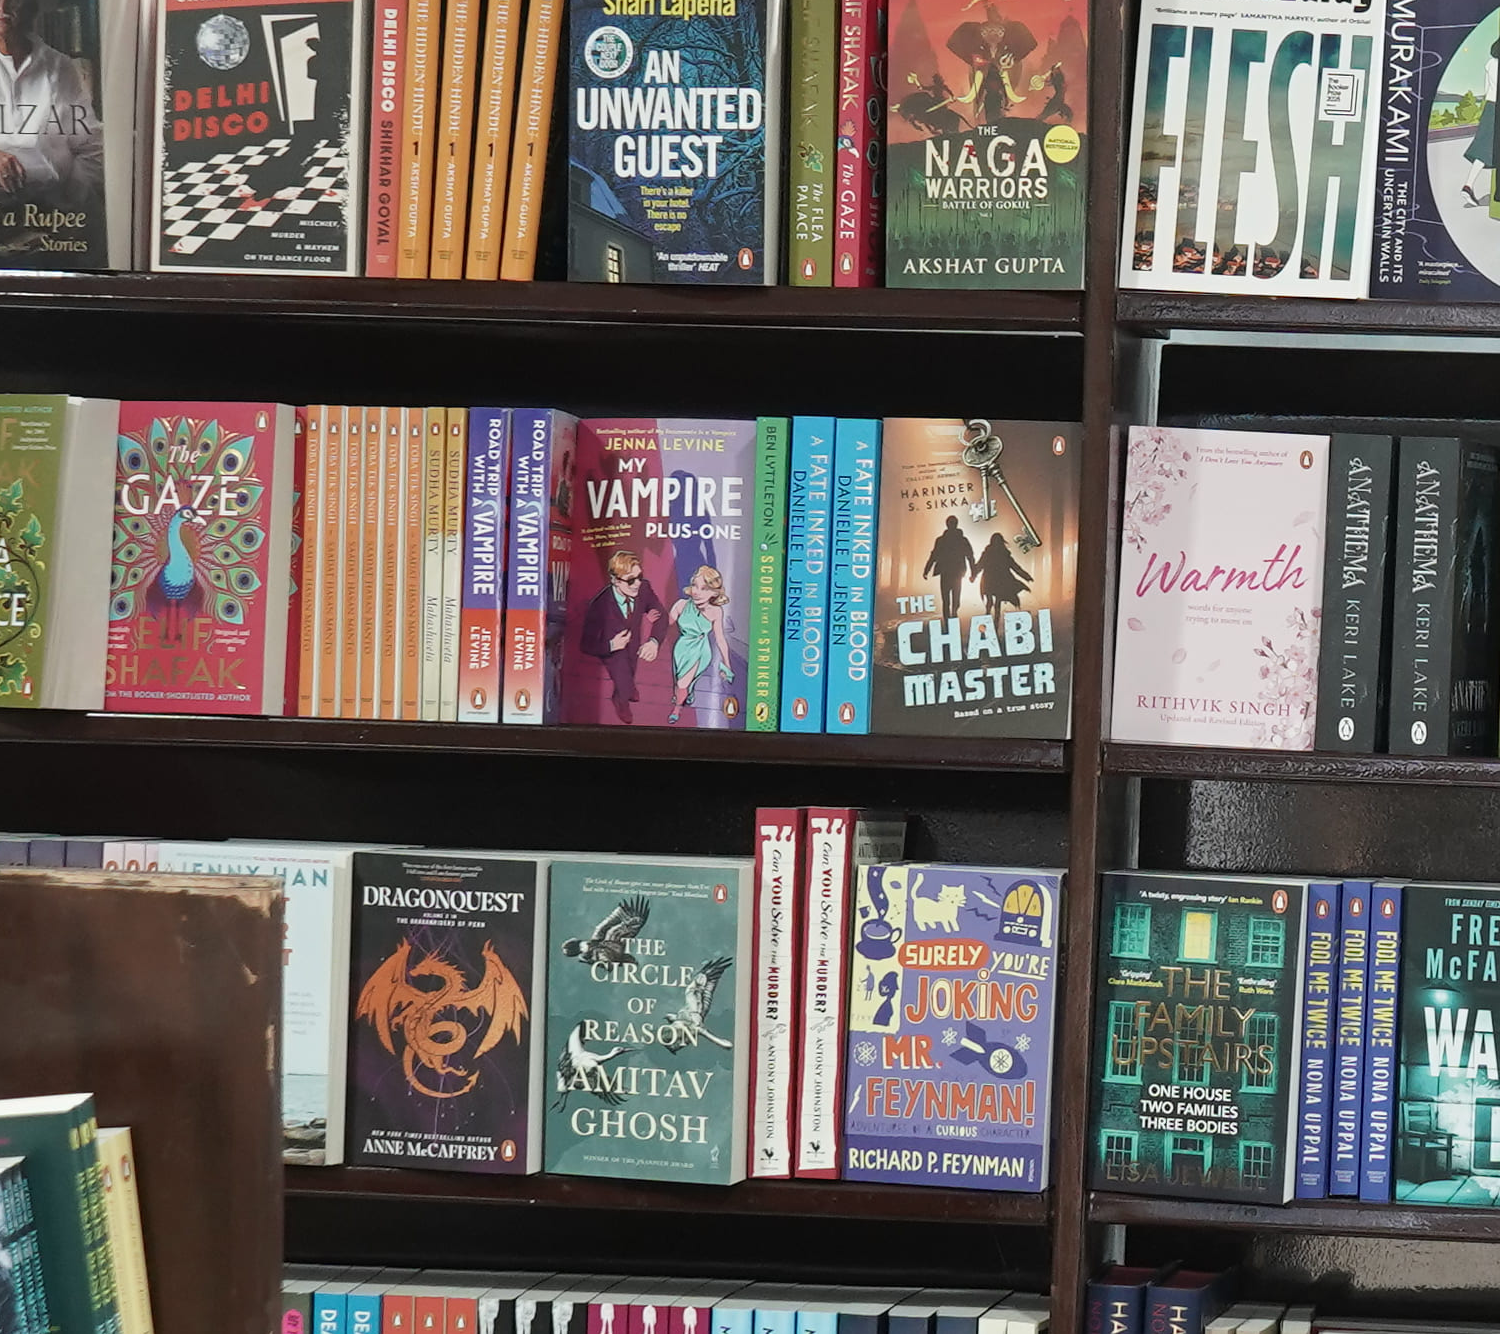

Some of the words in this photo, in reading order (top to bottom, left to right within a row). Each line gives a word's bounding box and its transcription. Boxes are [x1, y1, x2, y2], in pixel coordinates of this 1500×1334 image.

[644, 51, 680, 85] AN
[174, 81, 270, 112] DELHI
[577, 88, 762, 131] UNWANTED
[172, 111, 270, 141] DISCO
[614, 135, 723, 179] GUEST
[925, 136, 1047, 178] NAGA
[926, 178, 1049, 199] WARRIORS
[902, 256, 988, 275] AKSHAT
[996, 257, 1066, 275] GUPTA
[619, 458, 646, 474] MY
[121, 474, 241, 517] GAZE
[587, 476, 743, 521] VAMPIRE
[645, 522, 741, 541] PLUS-ONE
[1136, 542, 1309, 598] Warmth
[895, 596, 936, 613] THE
[900, 610, 1055, 668] CHABI
[904, 662, 1056, 707] MASTER
[362, 884, 525, 916] DRAGONQUEST
[623, 938, 667, 957] THE
[904, 943, 983, 967] SURELY
[990, 951, 1050, 978] YOU'RE
[590, 960, 695, 987] CIRCLE
[627, 998, 657, 1015] OF
[905, 969, 1038, 1024] JOKING
[583, 1019, 699, 1047] REASON
[882, 1034, 943, 1071] MR.
[565, 1065, 714, 1101] AMITAV
[865, 1077, 1036, 1126] FEYNMAN!
[570, 1107, 709, 1145] GHOSH
[849, 1148, 921, 1173] RICHARD
[926, 1151, 940, 1175] P.
[942, 1152, 1025, 1178] FEYNMAN
